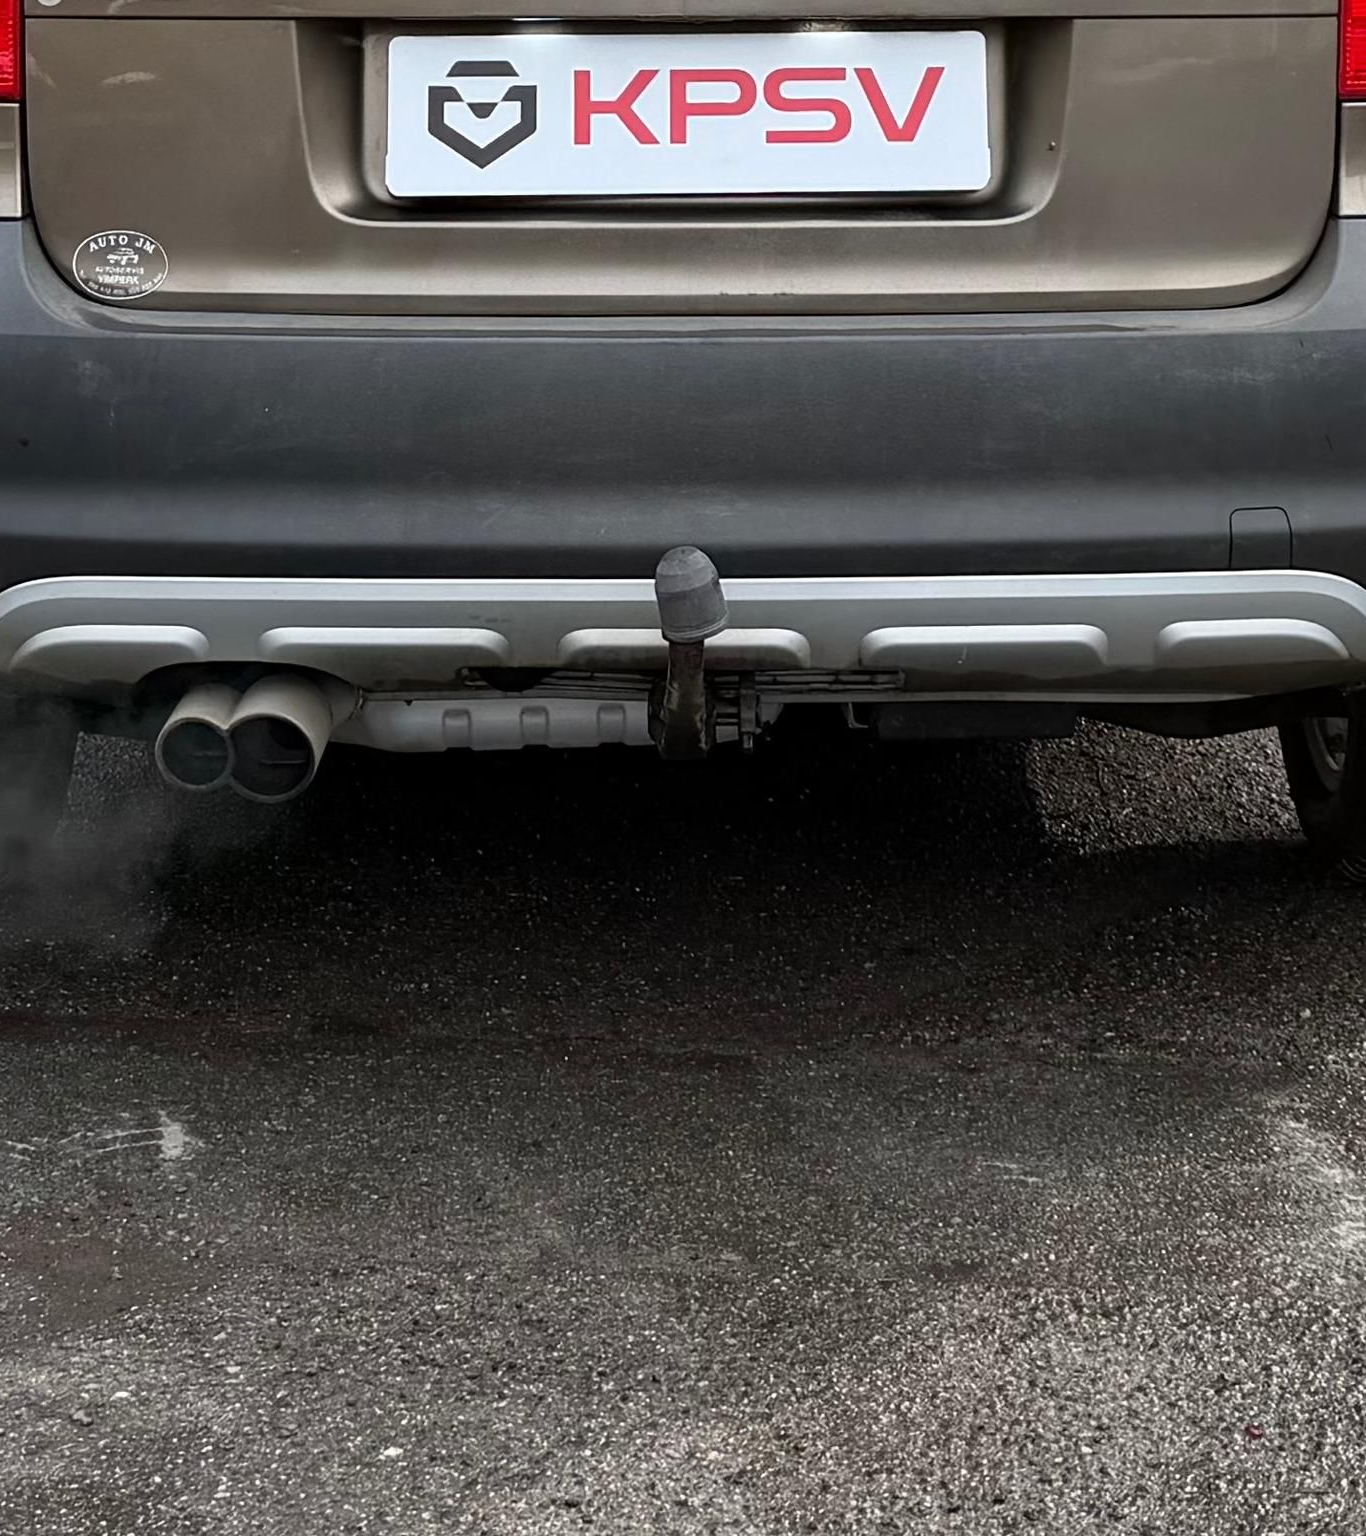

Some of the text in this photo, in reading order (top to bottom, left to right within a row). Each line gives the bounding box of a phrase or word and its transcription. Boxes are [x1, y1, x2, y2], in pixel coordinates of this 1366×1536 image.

[572, 66, 946, 146] KPSV
[89, 235, 156, 254] AUTO JM
